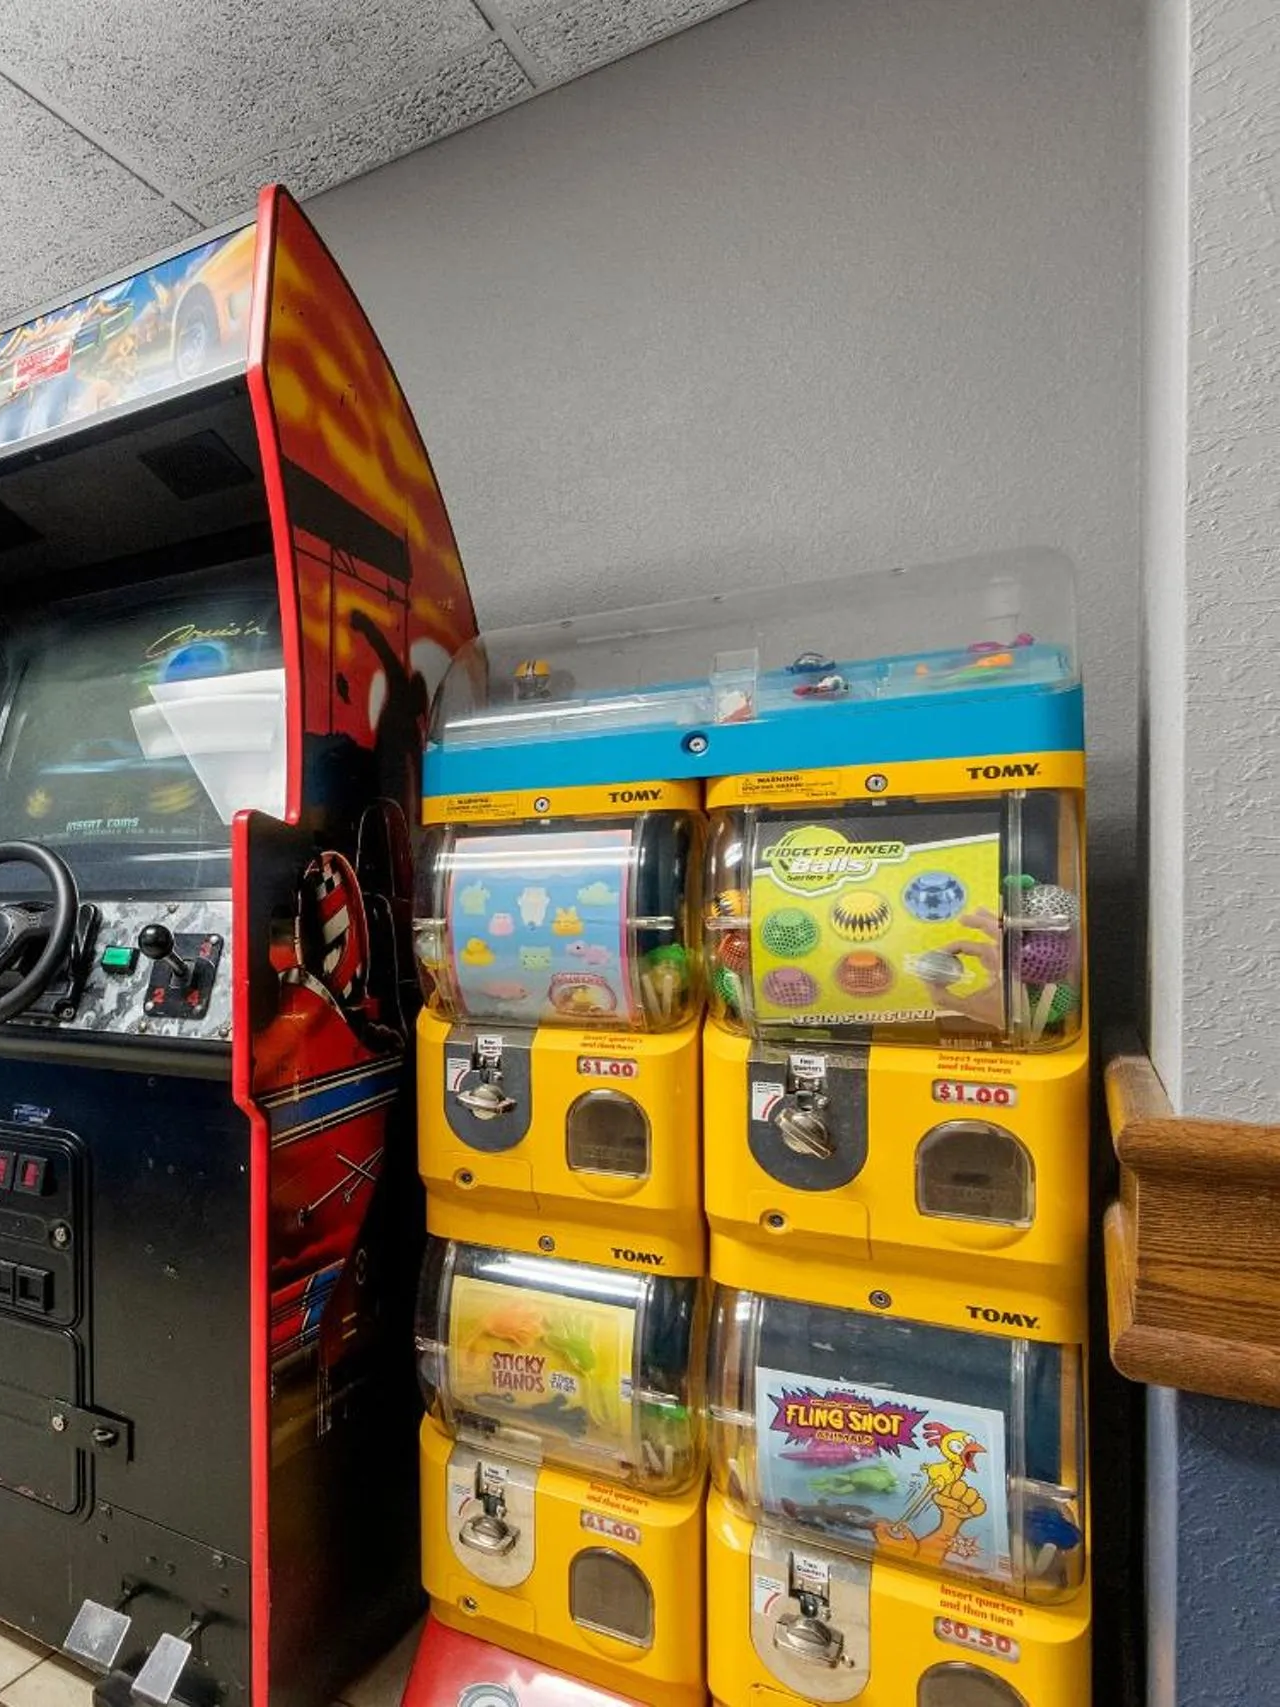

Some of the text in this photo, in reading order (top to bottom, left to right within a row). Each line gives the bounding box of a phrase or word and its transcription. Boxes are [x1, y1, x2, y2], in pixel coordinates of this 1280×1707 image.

[966, 763, 1040, 779] TOMY
[609, 788, 663, 803] TOMY
[766, 844, 900, 858] FIDGET SPINNER
[789, 855, 866, 873] Balls
[153, 987, 165, 1004] 2
[583, 1057, 634, 1077] $1.00
[940, 1082, 1010, 1104] $1.00
[611, 1248, 665, 1266] TOMY
[965, 1305, 1040, 1329] TOMY
[492, 1352, 545, 1374] STICKY
[492, 1371, 545, 1394] HANDS
[786, 1404, 844, 1430] FLING
[848, 1411, 904, 1435] SHOT
[940, 1584, 1024, 1617] Insert quarters
[940, 1600, 1014, 1628] and then turn
[941, 1618, 1012, 1653] $0.50
